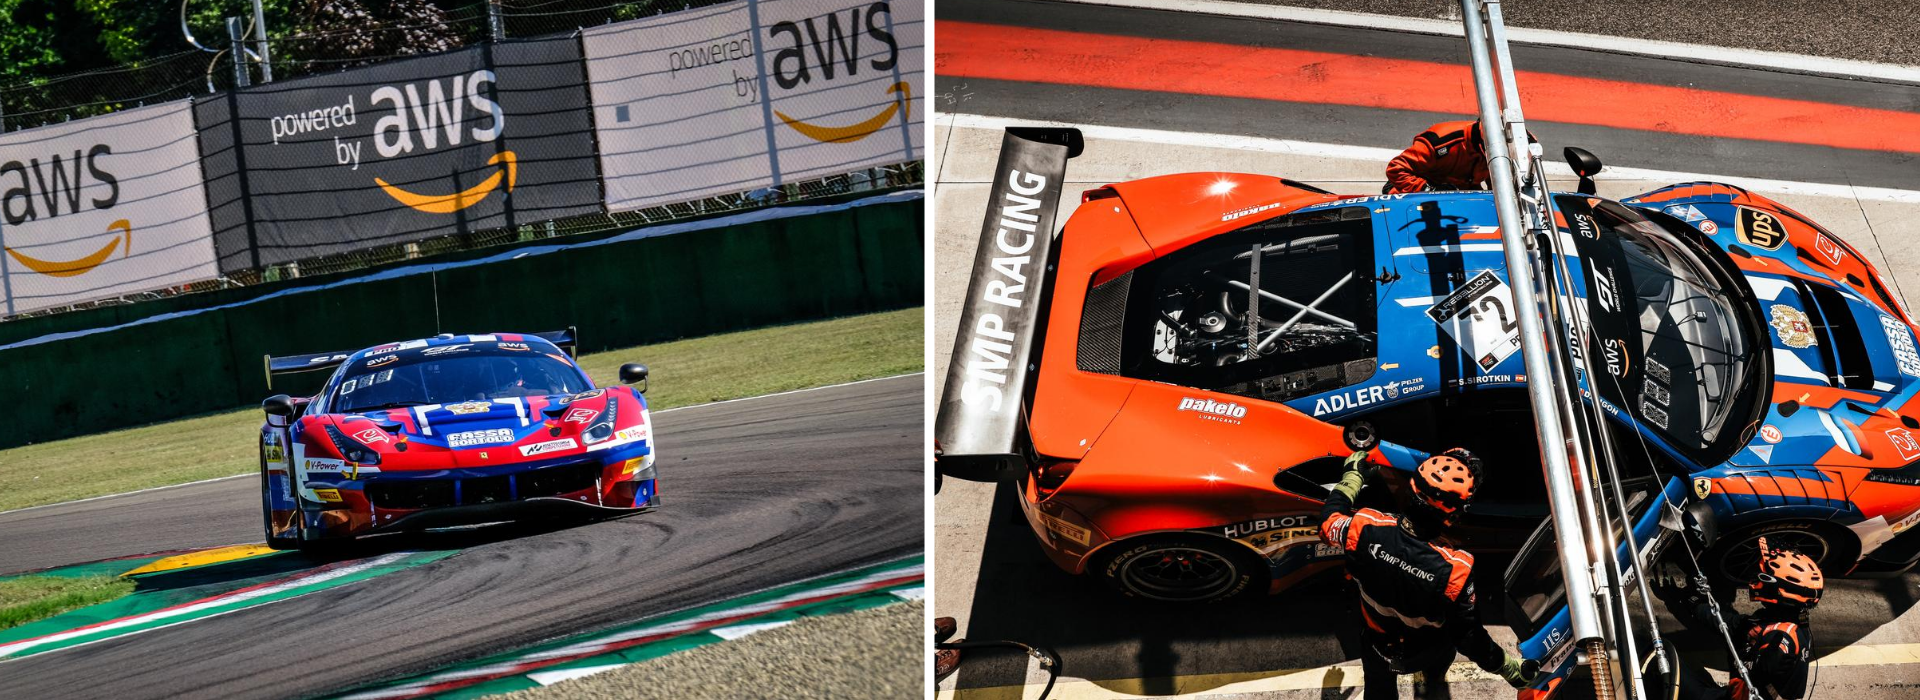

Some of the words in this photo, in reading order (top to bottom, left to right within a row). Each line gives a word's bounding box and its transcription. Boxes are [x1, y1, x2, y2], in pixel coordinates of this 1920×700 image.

[669, 31, 755, 78] powered
[770, 1, 899, 89] aws
[733, 70, 758, 102] by
[272, 101, 356, 144] powered
[371, 69, 505, 159] aws
[336, 137, 361, 170] by
[0, 144, 120, 226] aws
[983, 168, 1047, 309] RACING
[1575, 213, 1593, 239] aws
[1751, 211, 1781, 247] ups
[1443, 274, 1490, 310] REBELLION
[366, 353, 398, 366] aws
[497, 341, 529, 349] aws
[1604, 338, 1620, 377] aws
[960, 312, 1015, 413] SMP
[1401, 377, 1423, 387] PELZER
[1402, 384, 1425, 394] GROUP
[1459, 374, 1511, 386] S.SIROTKIN
[1178, 397, 1247, 418] pakelo
[1313, 385, 1386, 417] ADLER
[448, 428, 513, 441] FASSA
[449, 435, 514, 448] BORTOLO
[311, 461, 339, 470] V-Power
[1224, 515, 1308, 538] HUBLOT
[1378, 551, 1400, 565] SMP
[1399, 561, 1436, 582] RACING
